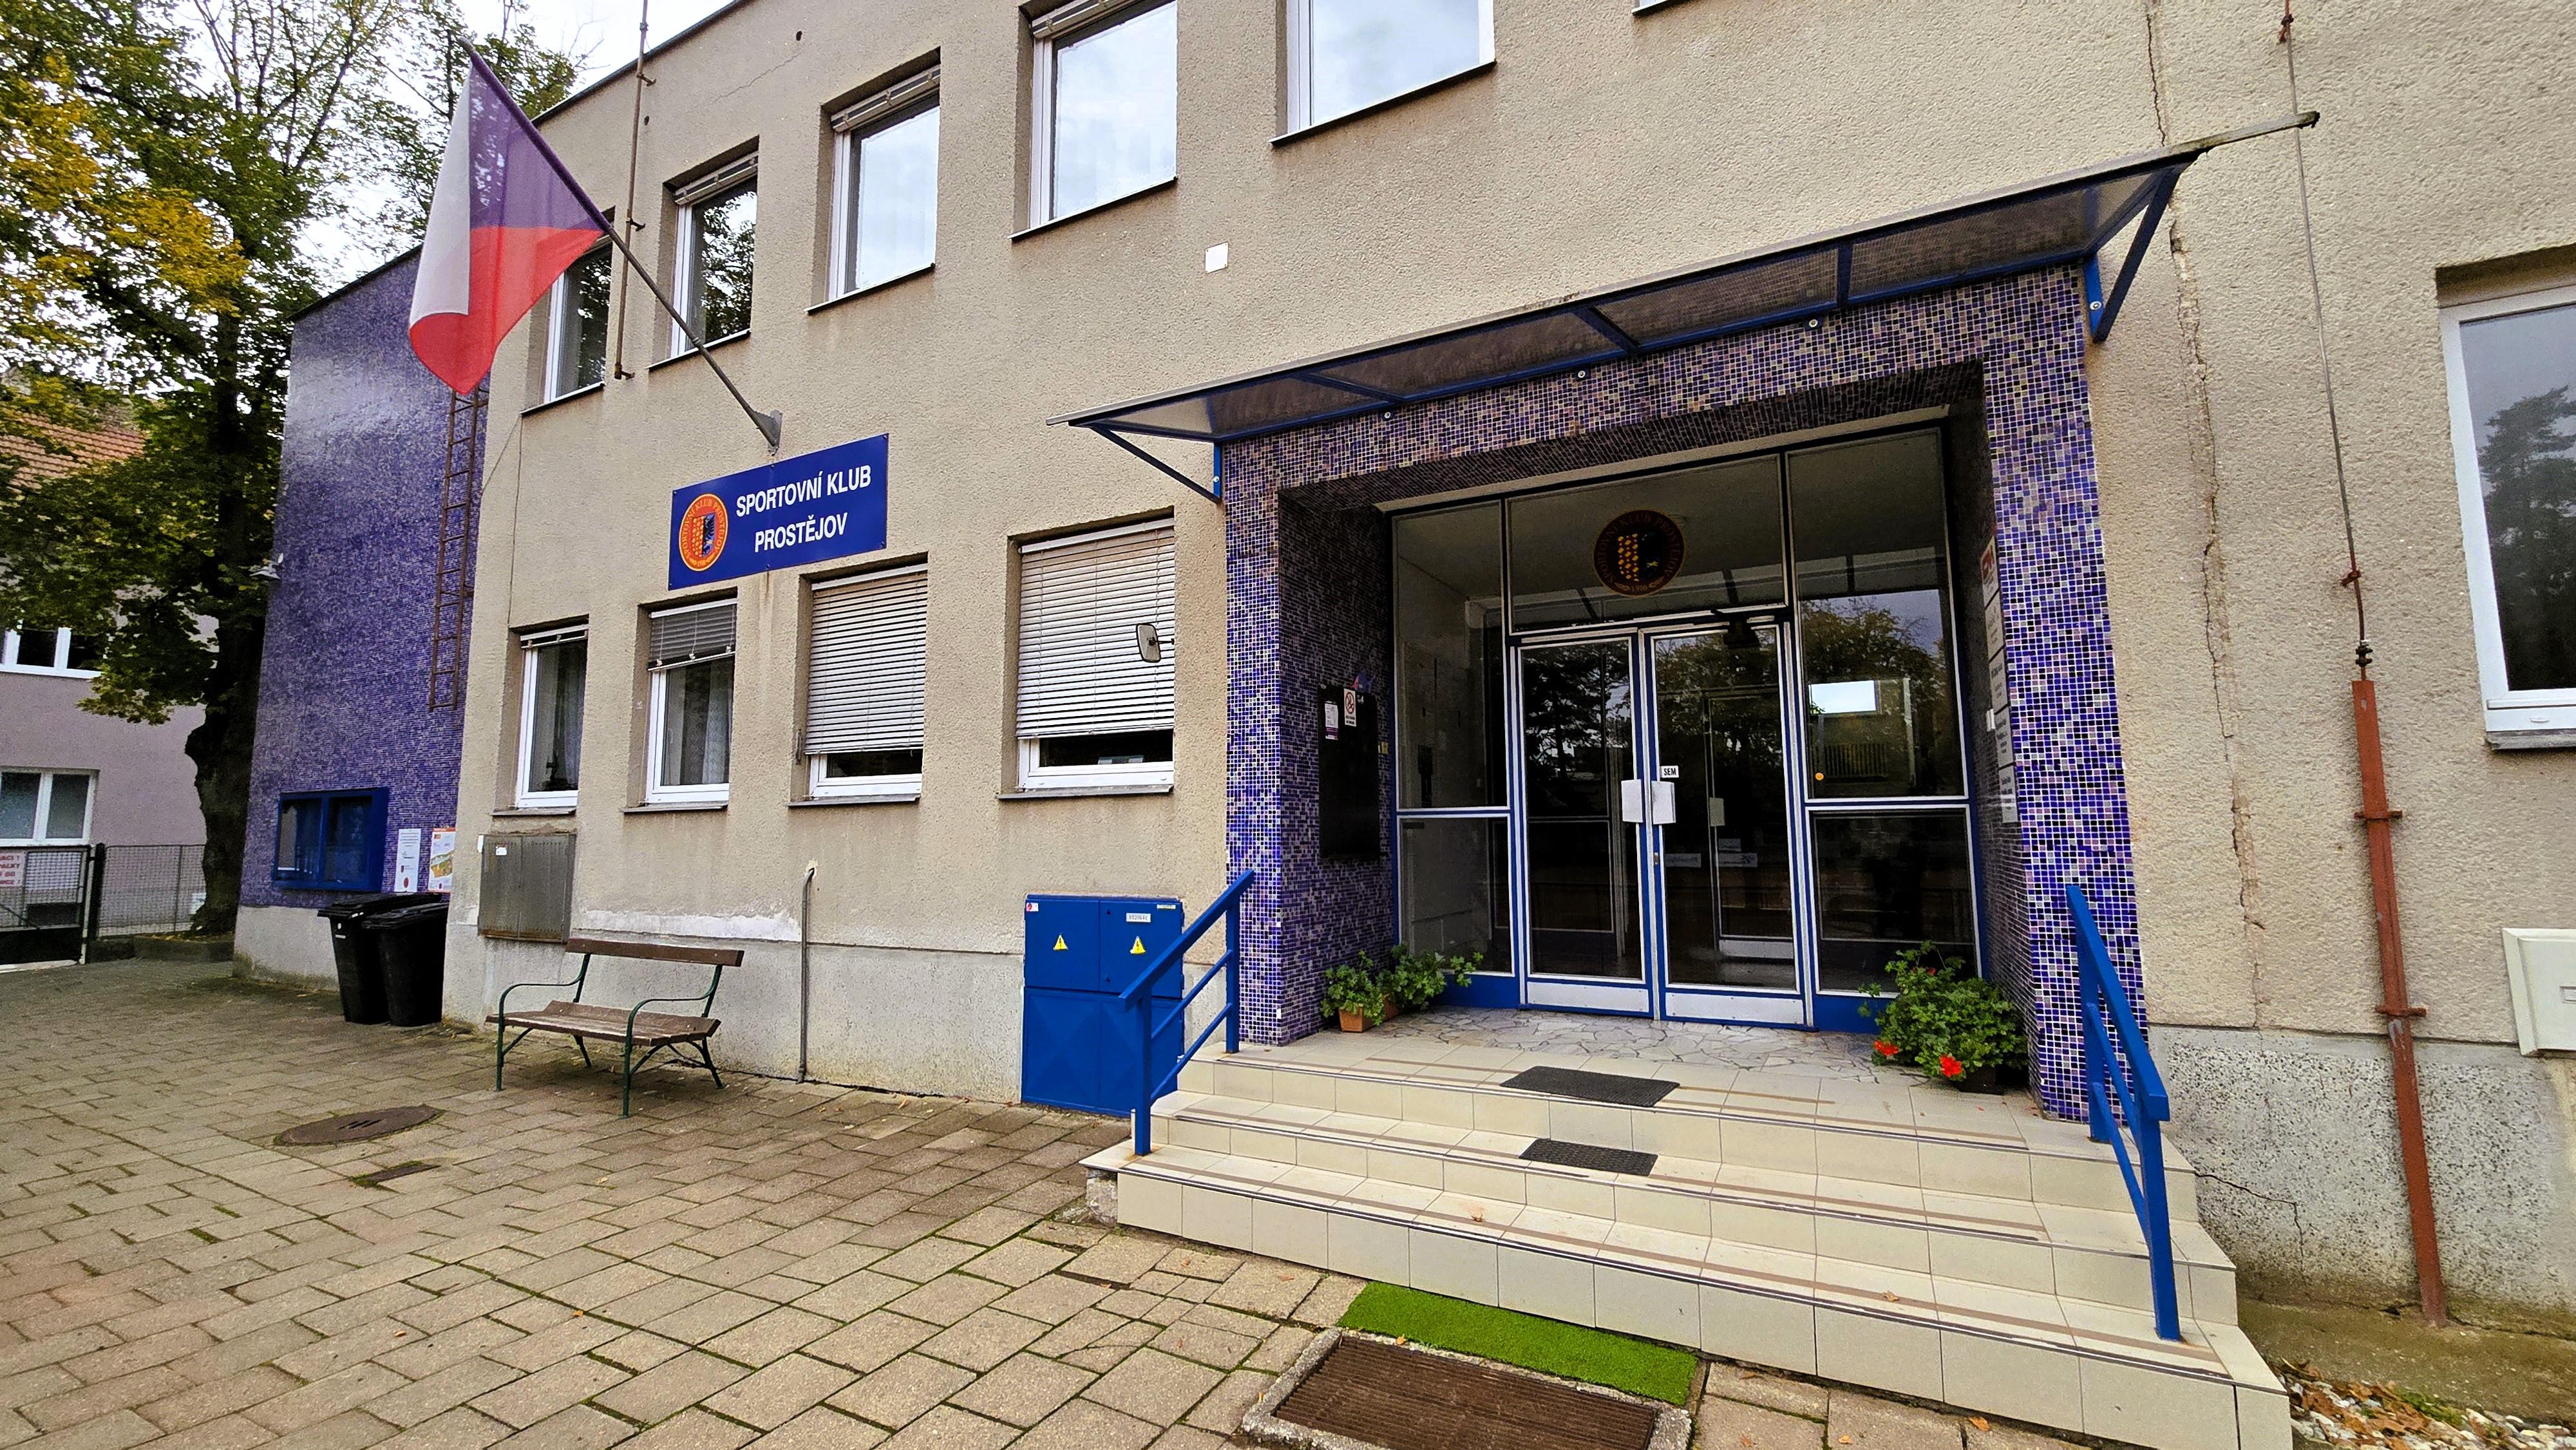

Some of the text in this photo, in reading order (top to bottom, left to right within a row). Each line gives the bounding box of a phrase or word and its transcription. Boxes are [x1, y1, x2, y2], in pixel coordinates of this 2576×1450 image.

[735, 465, 871, 517] SPORTOVNÍ KLUB
[755, 512, 848, 553] PROSTĚJOV
